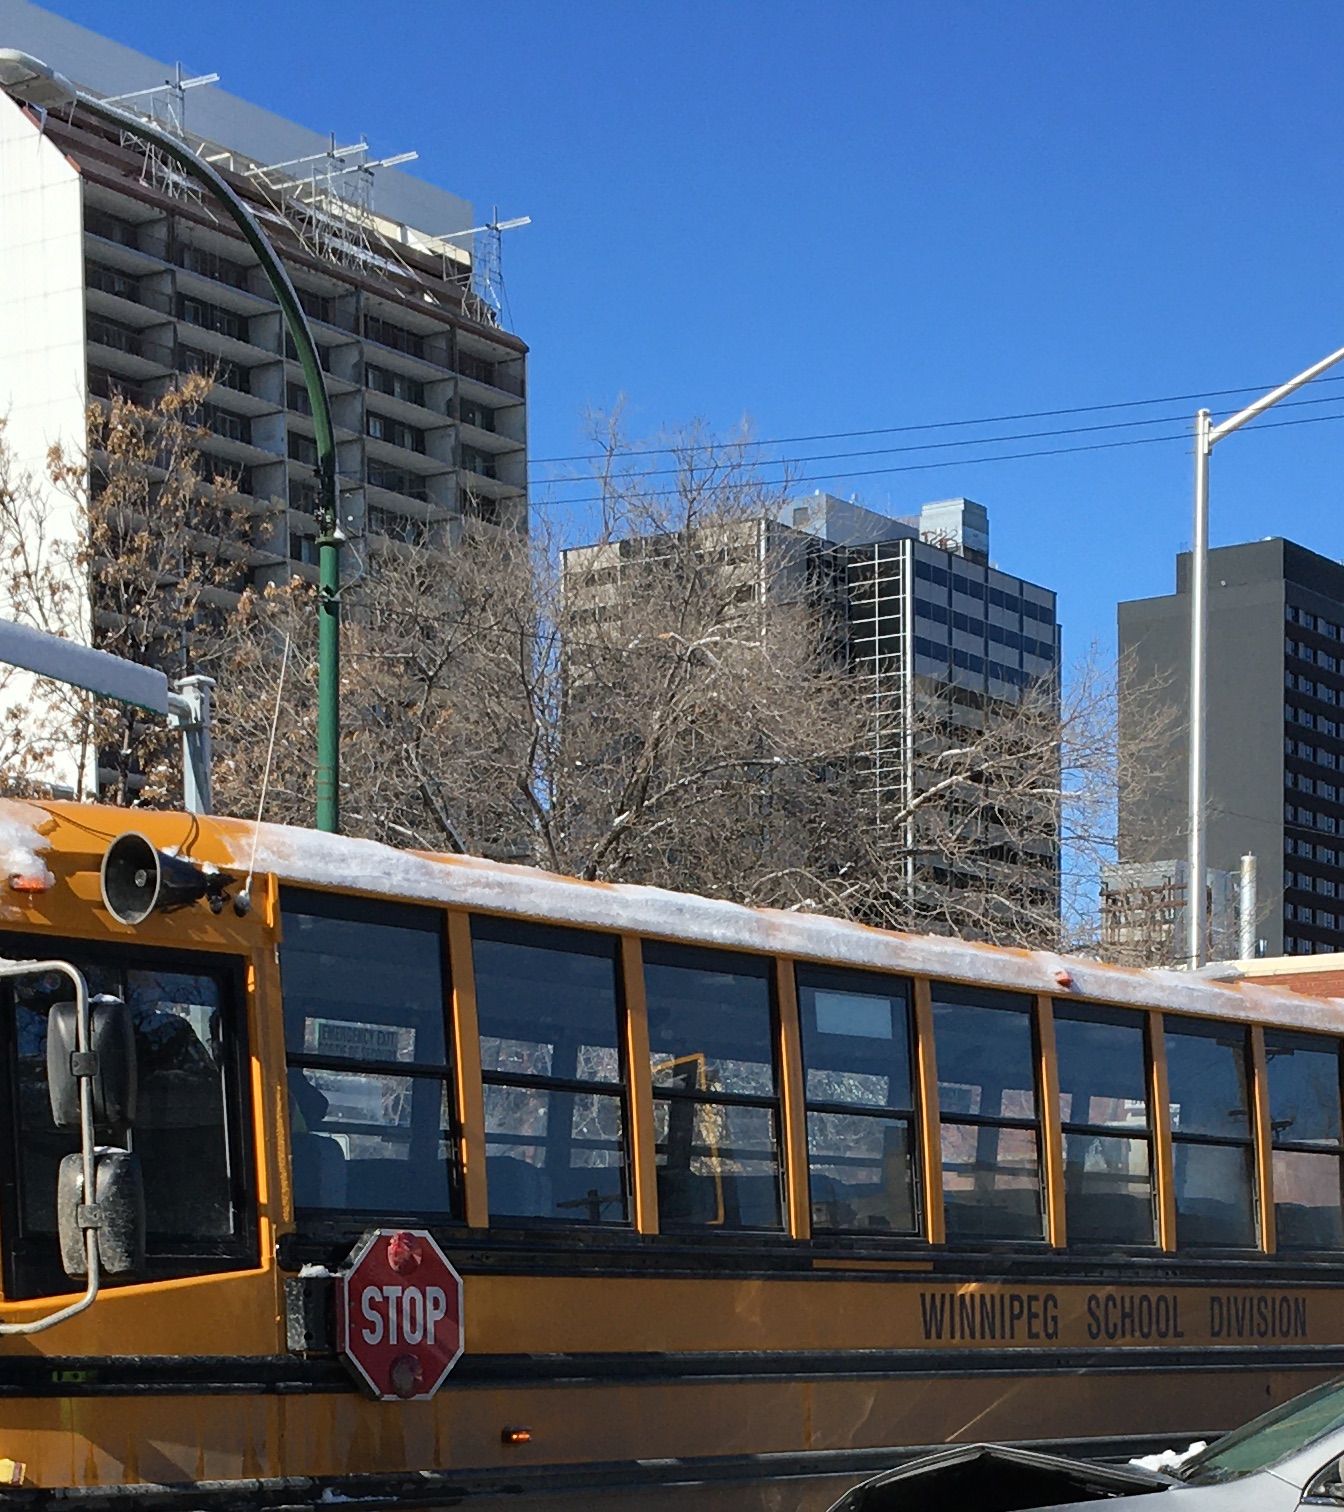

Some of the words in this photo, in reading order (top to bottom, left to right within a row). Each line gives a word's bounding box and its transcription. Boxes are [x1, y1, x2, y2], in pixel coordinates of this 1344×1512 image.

[361, 1285, 447, 1345] STOP
[919, 1292, 1059, 1340] WINNIPEG
[1087, 1294, 1184, 1339] SCHOOL
[1210, 1295, 1307, 1338] DIVISION
